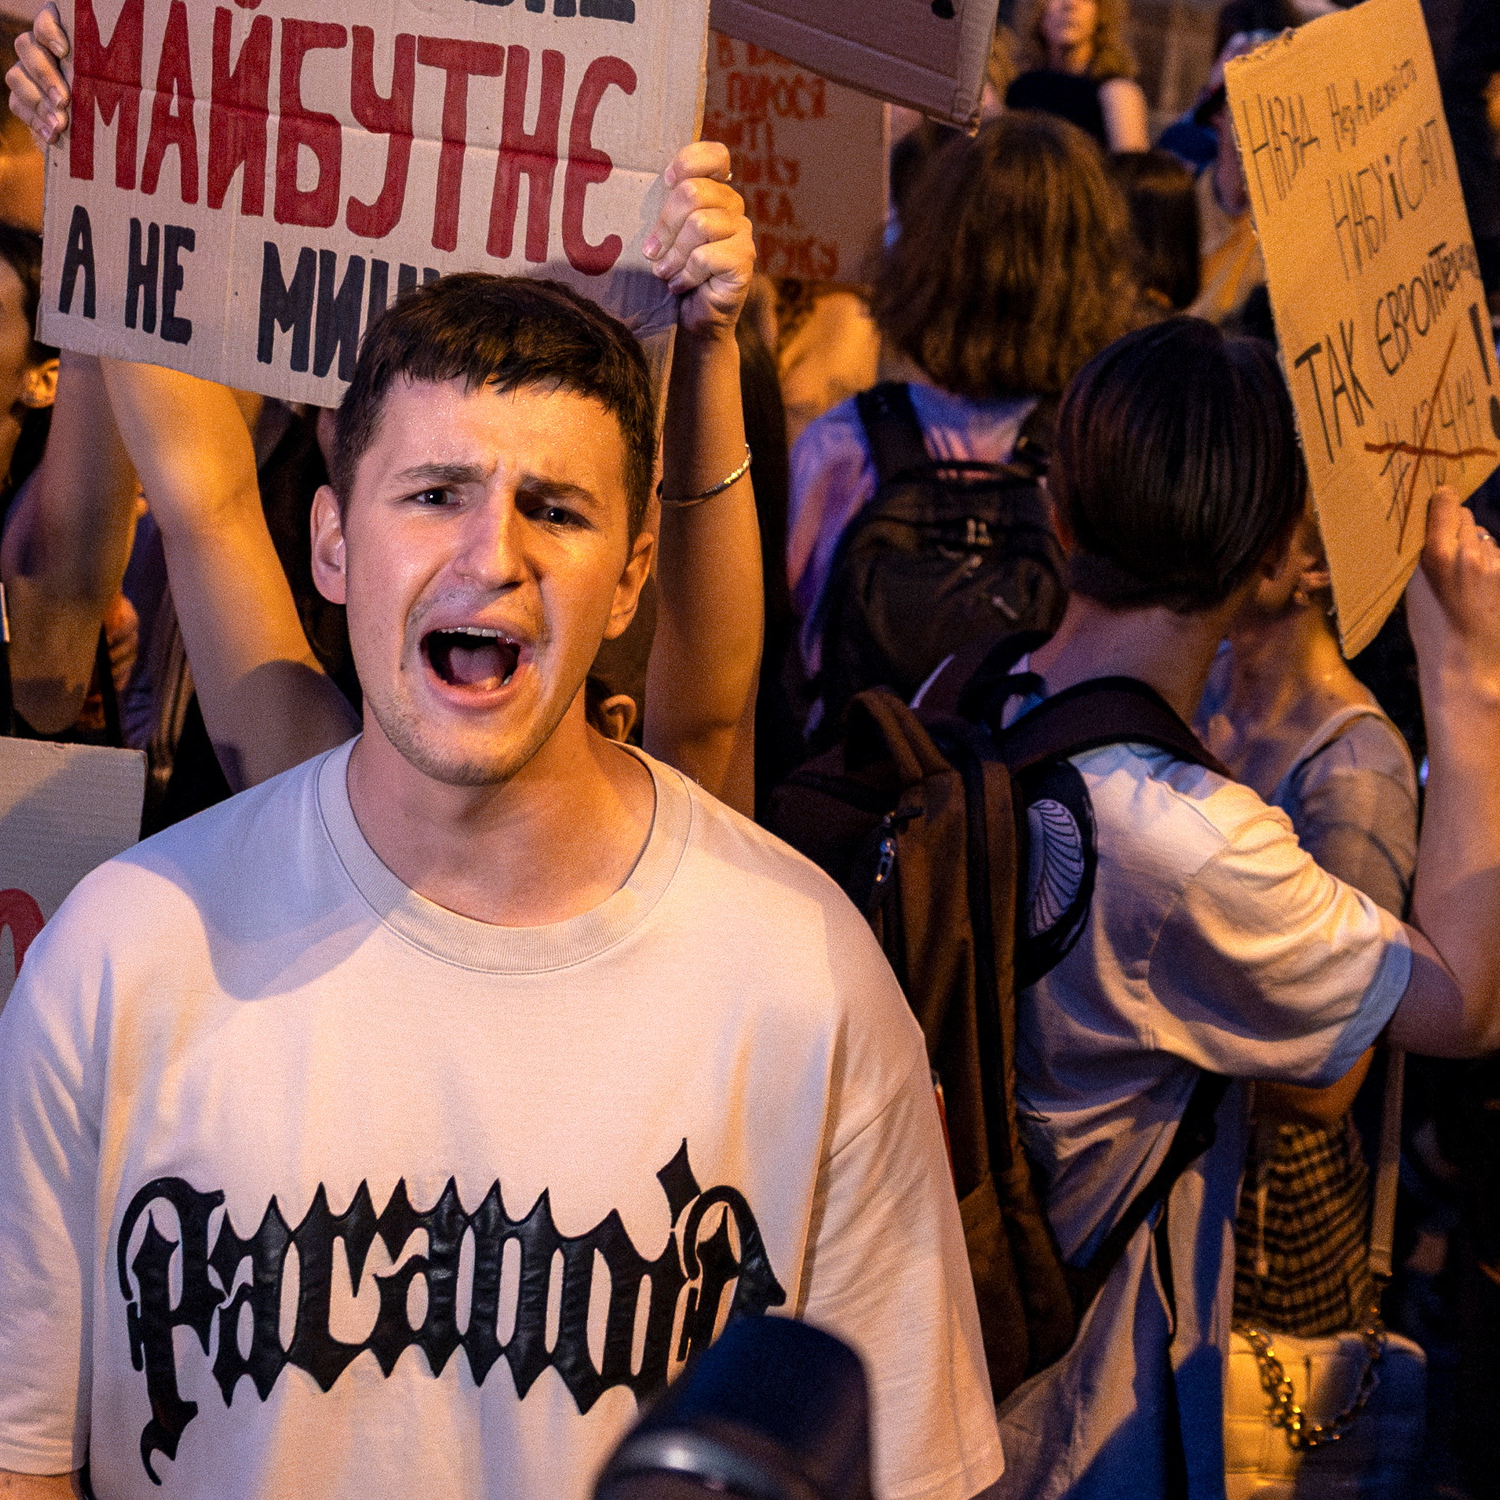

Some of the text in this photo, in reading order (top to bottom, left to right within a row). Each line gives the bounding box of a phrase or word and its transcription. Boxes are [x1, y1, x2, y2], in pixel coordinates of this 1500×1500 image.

[57, 204, 97, 320] А
[125, 217, 195, 346] НЕ
[1294, 319, 1375, 464] ТАК
